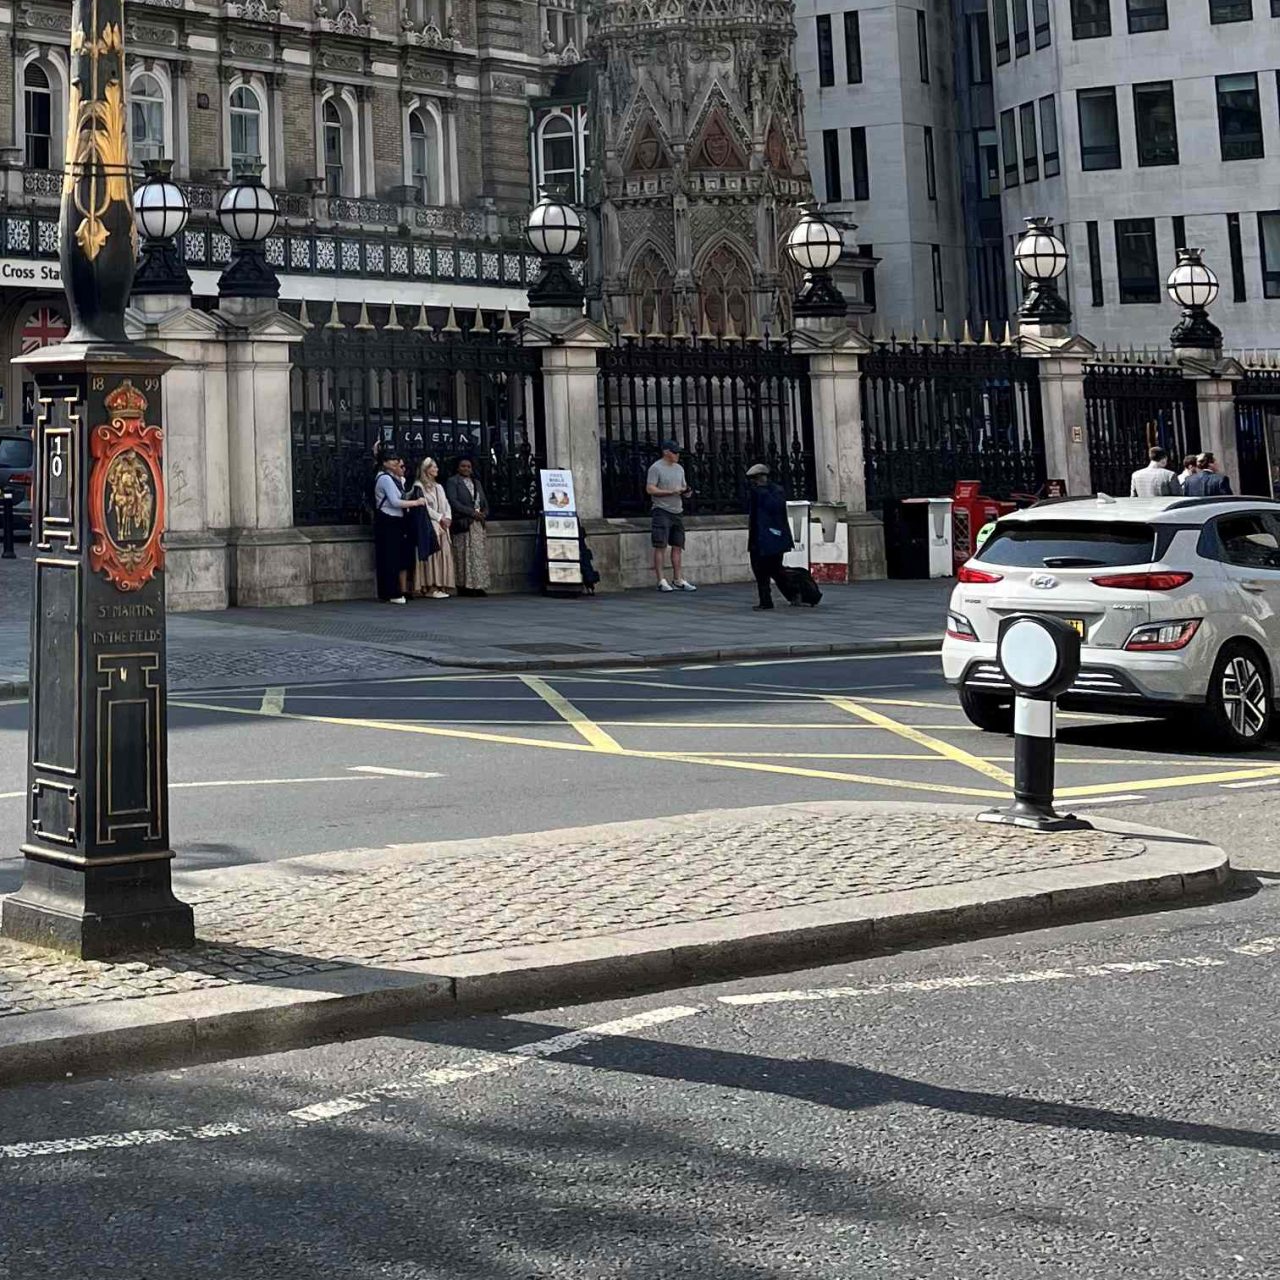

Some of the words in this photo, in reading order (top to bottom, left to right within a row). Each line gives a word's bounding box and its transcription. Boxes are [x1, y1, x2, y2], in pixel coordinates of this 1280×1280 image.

[2, 263, 35, 279] Cross
[40, 265, 62, 280] Sta
[92, 377, 105, 391] 18
[145, 378, 160, 391] 99
